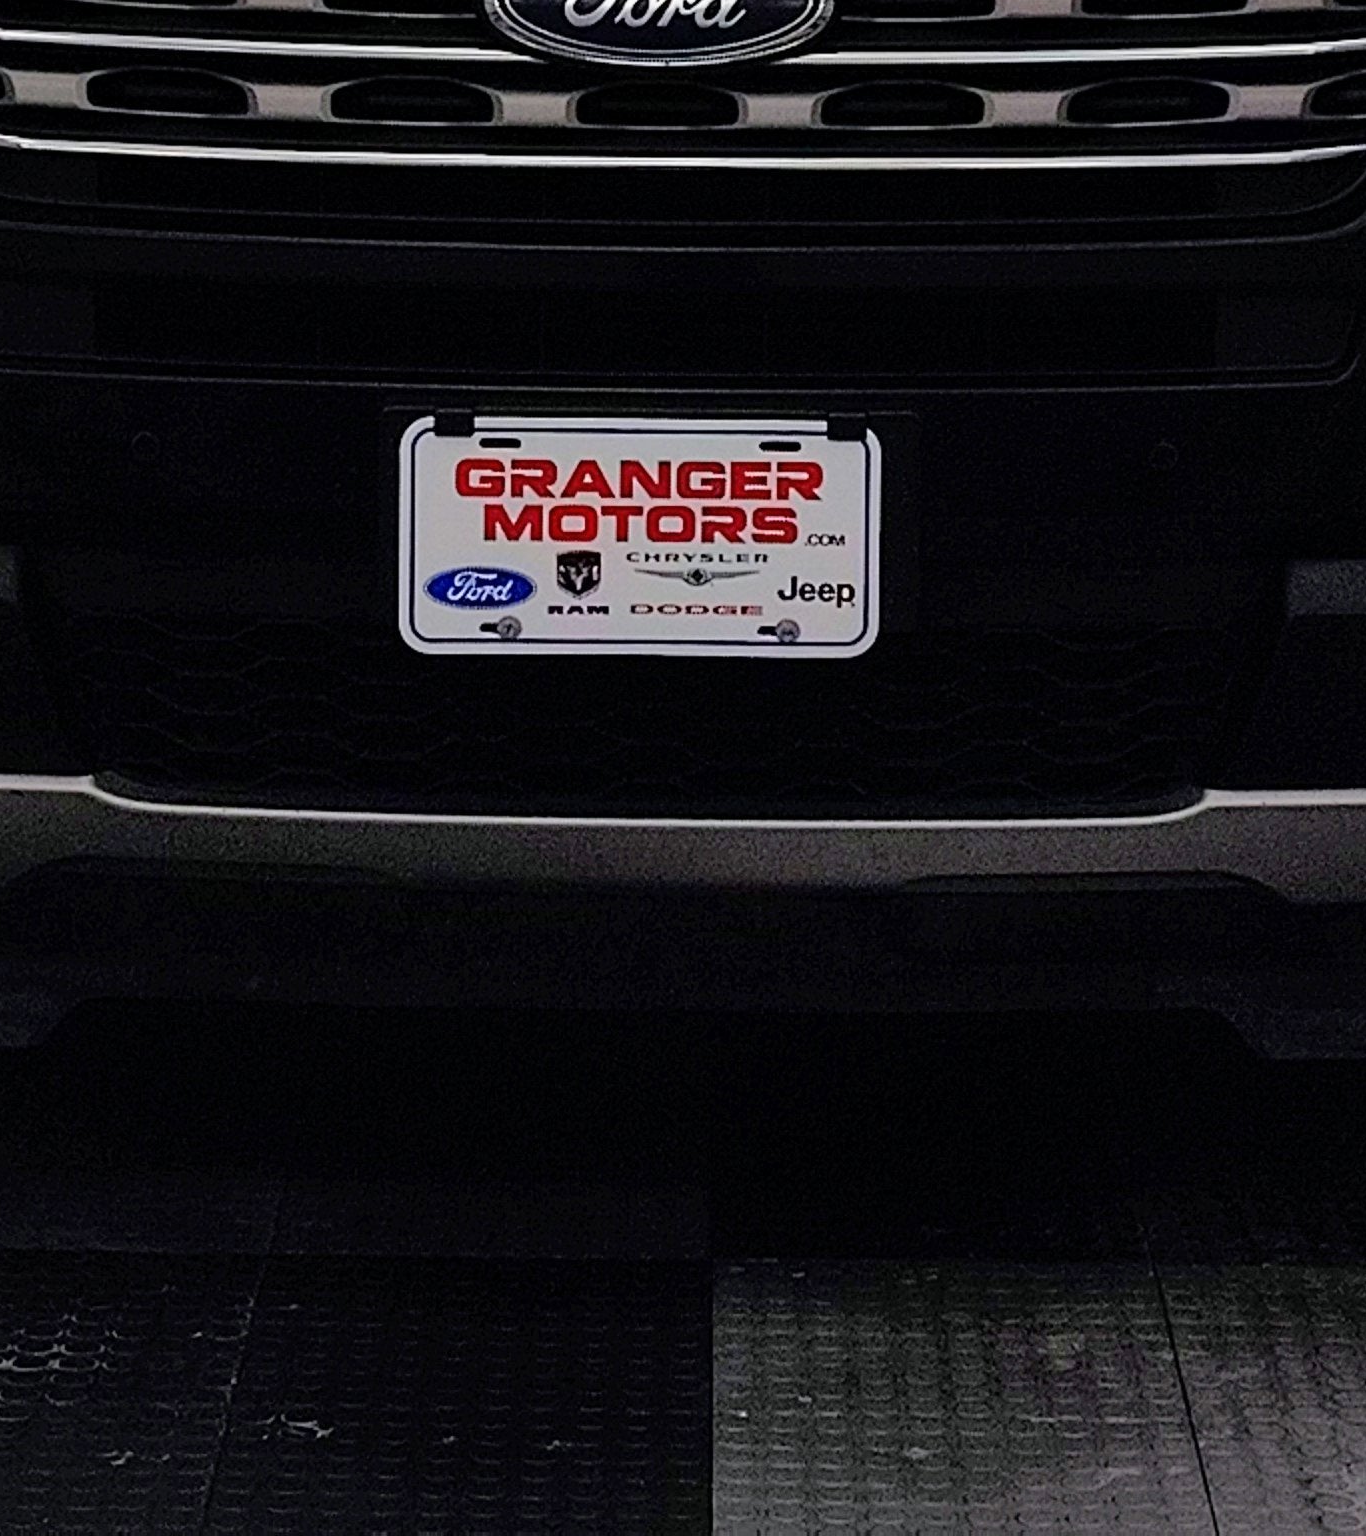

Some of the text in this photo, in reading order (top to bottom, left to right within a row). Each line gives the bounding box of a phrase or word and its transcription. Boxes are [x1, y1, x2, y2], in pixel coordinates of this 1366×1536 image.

[455, 458, 824, 501] GRANGER
[483, 504, 799, 544] MOTORS
[626, 552, 769, 563] CHRYSLER
[446, 571, 514, 602] Ford
[777, 575, 856, 609] Jeep
[547, 605, 610, 615] RAM
[630, 604, 764, 615] DODGE
